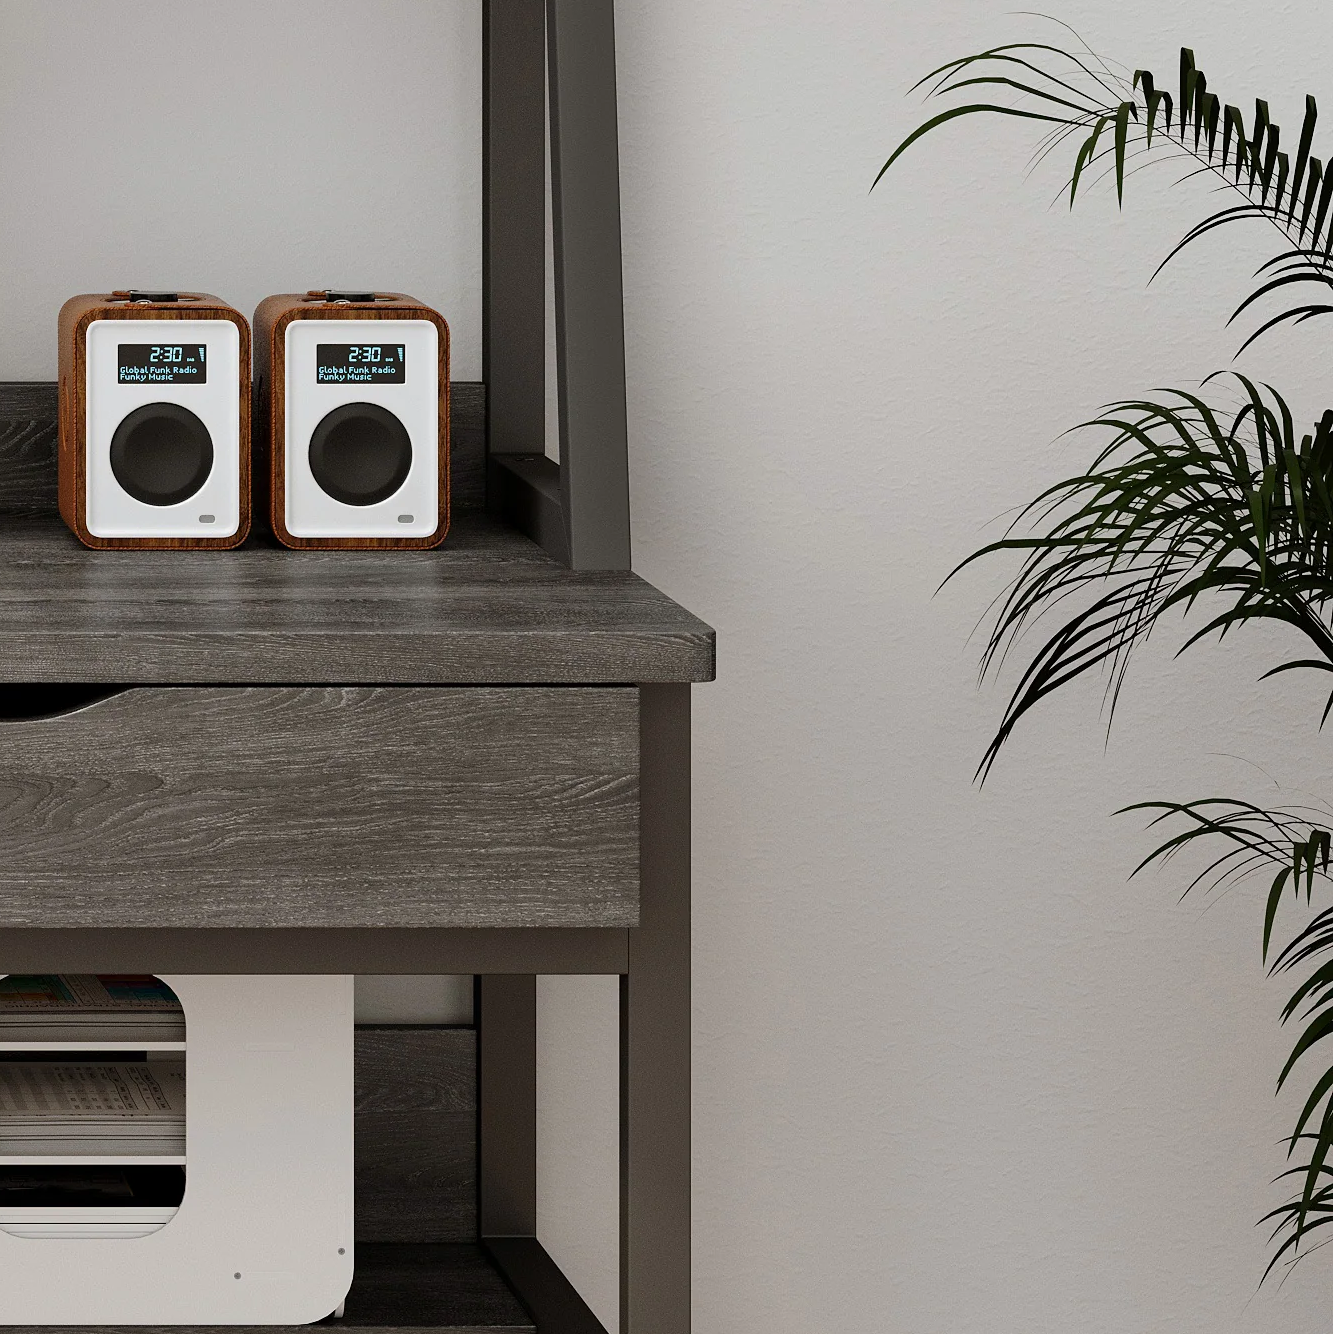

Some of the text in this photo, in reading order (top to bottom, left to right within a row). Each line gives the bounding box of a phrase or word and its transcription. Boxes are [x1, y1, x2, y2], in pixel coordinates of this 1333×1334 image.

[149, 347, 183, 362] 2:30
[349, 347, 381, 362] 2:30
[120, 366, 197, 374] Global Funk Radio
[319, 366, 396, 374] Global Funk Radio
[120, 373, 173, 382] Funky Music
[319, 373, 372, 382] Funky Music
